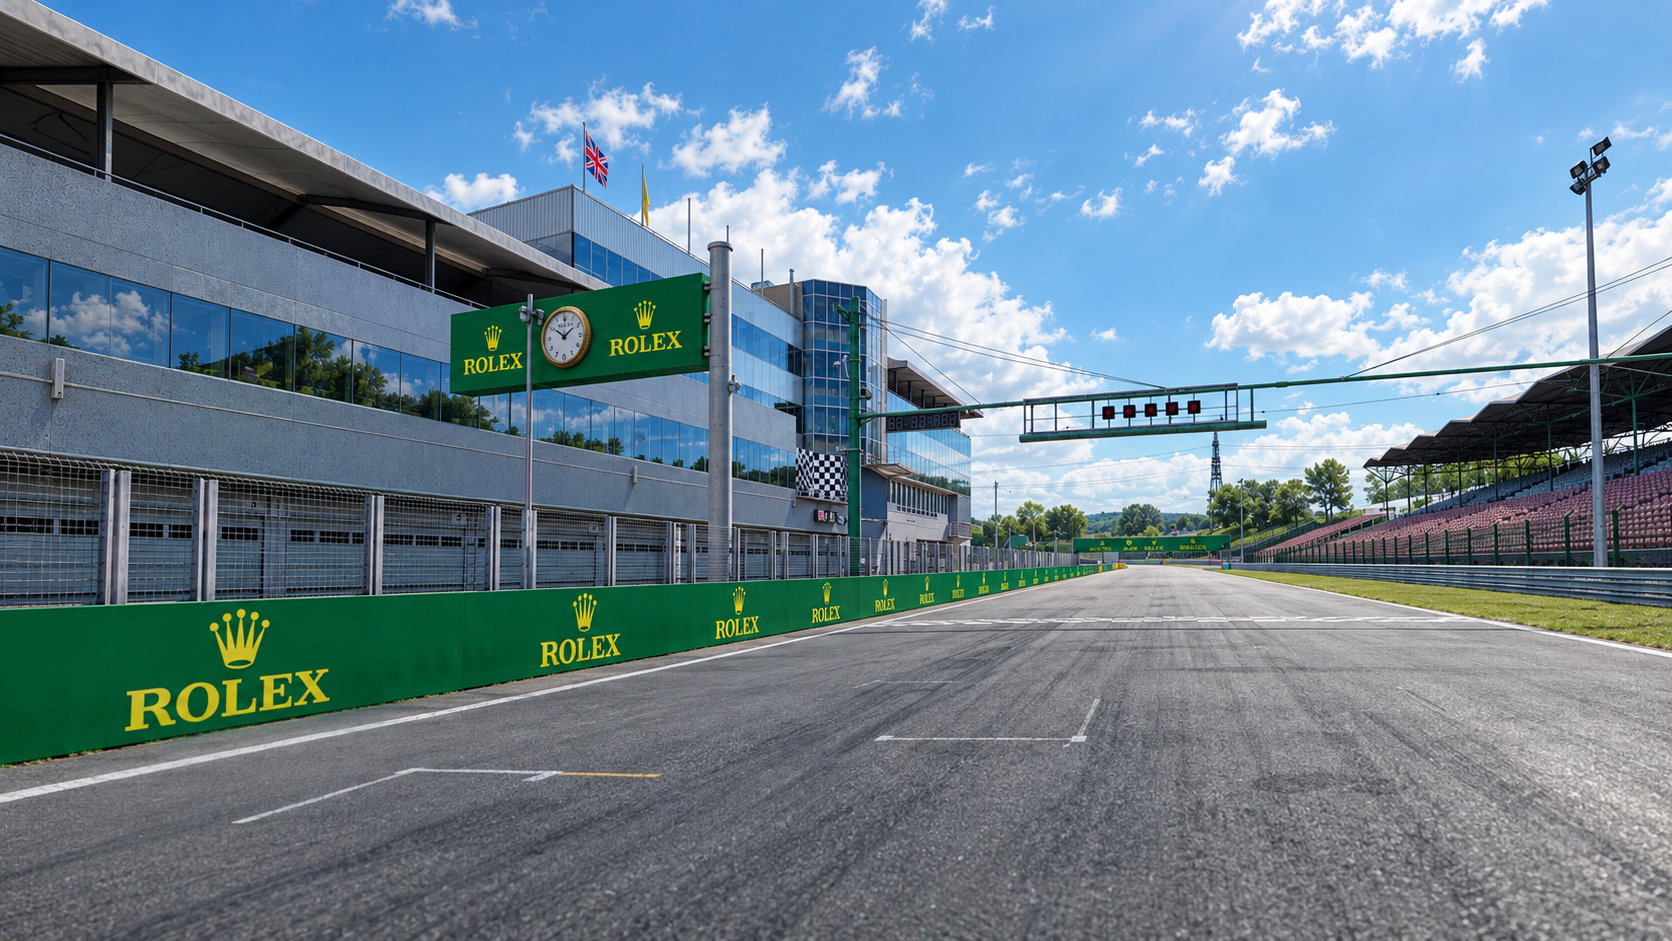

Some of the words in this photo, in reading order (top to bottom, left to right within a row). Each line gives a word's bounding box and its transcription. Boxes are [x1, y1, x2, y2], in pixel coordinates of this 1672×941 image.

[609, 330, 683, 357] ROLEX
[463, 352, 523, 375] ROLEX
[811, 605, 841, 624] ROLEX
[874, 598, 895, 612] ROLEX
[715, 615, 760, 640] ROLEX
[539, 633, 621, 668] ROLEX
[124, 668, 330, 732] ROLEX
